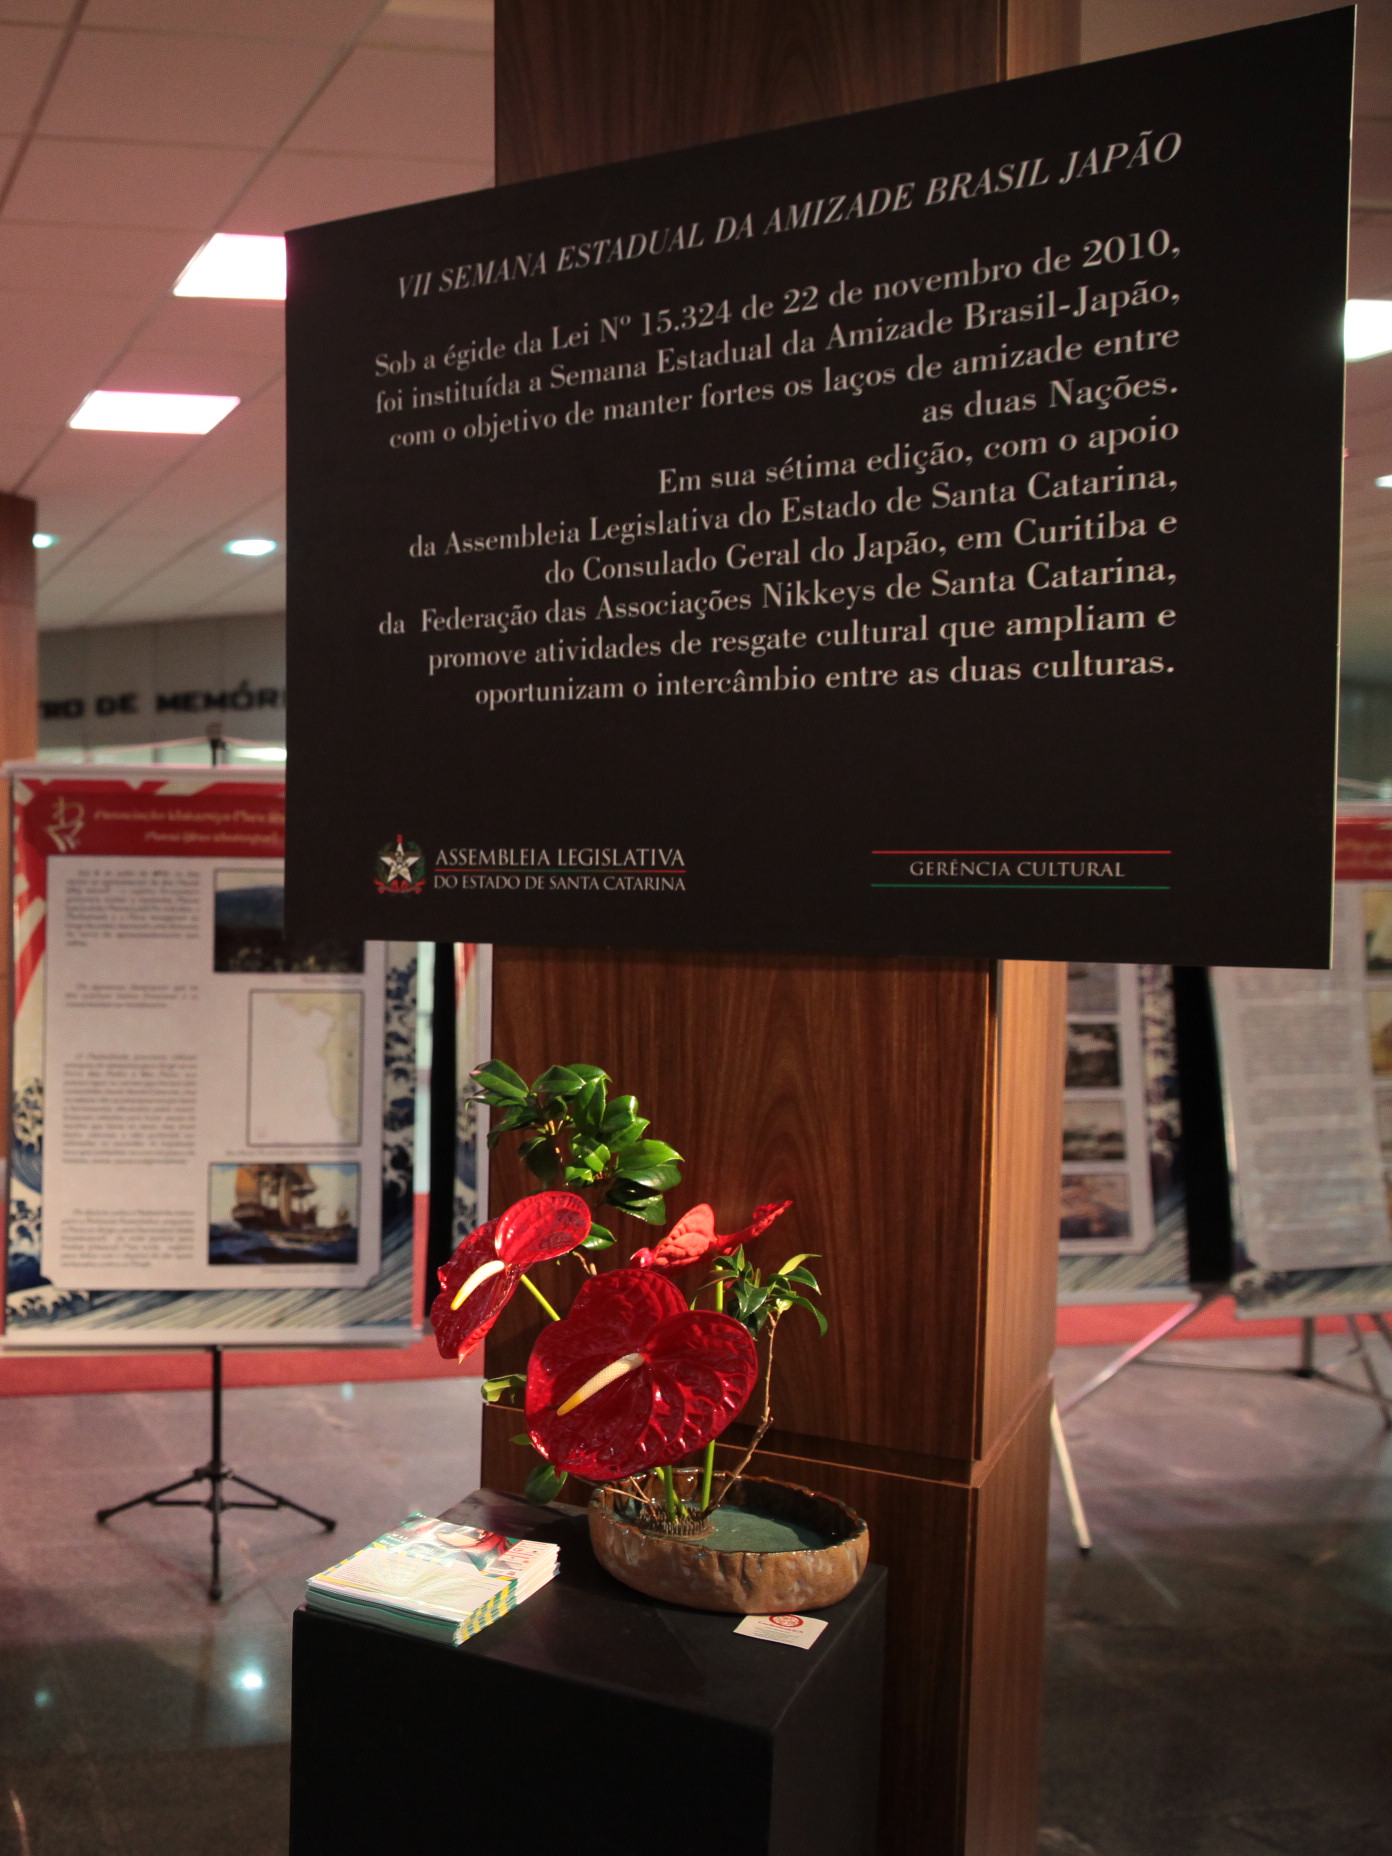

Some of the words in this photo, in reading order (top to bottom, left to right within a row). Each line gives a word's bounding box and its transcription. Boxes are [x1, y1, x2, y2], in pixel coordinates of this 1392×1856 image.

[398, 272, 433, 300] VII
[439, 250, 548, 293] SEMANA
[556, 221, 706, 274] ESTADUAL
[714, 213, 754, 245] DA
[763, 181, 916, 234] AMIZADE
[924, 157, 1049, 206] BRASIL
[1058, 130, 1182, 185] JAPÃO
[375, 350, 417, 377] Sob
[423, 354, 436, 370] a
[443, 336, 506, 371] égide
[513, 330, 543, 355] da
[552, 322, 589, 350] Lei
[643, 299, 732, 336] 15.324
[741, 293, 774, 320] de
[783, 285, 819, 315] 22
[828, 279, 863, 307] de
[874, 257, 1023, 301] novembro
[1032, 245, 1072, 275] de
[1082, 229, 1181, 268] 2010,
[376, 388, 403, 414] foi
[412, 372, 521, 409] instituída
[528, 376, 542, 393] a
[550, 361, 647, 389] Semana
[657, 332, 772, 374] Estadual
[781, 328, 816, 356] da
[826, 308, 953, 350] Amizade
[965, 279, 1180, 330] Brasil-Japão,
[389, 429, 435, 448] com
[442, 427, 457, 441] o
[462, 408, 558, 443] objetivo
[564, 400, 595, 426] de
[603, 394, 693, 421] manter
[701, 382, 775, 409] fortes
[783, 379, 814, 397] os
[824, 366, 897, 397] laços
[906, 353, 943, 381] de
[952, 334, 1083, 376] amizade
[1093, 329, 1180, 357] entre
[921, 404, 954, 424] as
[963, 389, 1037, 418] duas
[1049, 374, 1178, 411] Nações.
[659, 467, 702, 495] Em
[710, 468, 756, 488] sua
[765, 453, 857, 483] sétima
[866, 441, 973, 475] edição,
[983, 436, 1048, 460] com
[1058, 434, 1078, 451] o
[1087, 414, 1180, 456] apoio
[408, 533, 436, 558] da
[445, 520, 581, 555] Assembleia
[590, 507, 729, 545] Legislativa
[737, 500, 772, 527] do
[781, 490, 877, 524] Estado
[885, 485, 922, 514] de
[931, 481, 1017, 509] Santa
[1027, 464, 1178, 500] Catarina,
[544, 559, 575, 584] do
[582, 546, 718, 581] Consulado
[725, 538, 800, 570] Geral
[810, 535, 845, 563] do
[852, 531, 947, 565] Japão,
[956, 530, 1002, 551] em
[1013, 509, 1148, 546] Curitiba
[1158, 515, 1178, 535] e
[378, 611, 406, 635] da
[421, 604, 538, 634] Federação
[544, 598, 587, 624] das
[595, 589, 752, 621] Associações
[762, 578, 876, 611] Nikkeys
[885, 572, 922, 600] de
[931, 569, 1016, 597] Santa
[1026, 556, 1177, 590] Catarina,
[428, 649, 527, 677] promove
[534, 632, 662, 664] atividades
[670, 629, 702, 655] de
[711, 628, 807, 658] resgate
[816, 613, 929, 647] cultural
[938, 620, 996, 648] que
[1005, 603, 1146, 642] ampliam
[1156, 609, 1177, 628] e
[95, 692, 139, 718] DE
[156, 678, 288, 713] MEMÓR
[474, 676, 624, 711] oportunizam
[632, 681, 648, 697] o
[657, 664, 817, 697] intercâmbio
[824, 666, 899, 689] entre
[907, 667, 940, 686] as
[949, 655, 1022, 683] duas
[1031, 649, 1175, 680] culturas.
[433, 875, 459, 889] DO
[462, 875, 521, 889] ESTADO
[524, 875, 543, 890] DE
[549, 876, 600, 890] SANTA
[602, 876, 686, 891] CATARINA
[435, 848, 551, 866] ASSEMBLEIA
[557, 848, 685, 867] LEGISLATIVA
[909, 857, 1011, 877] GERÊNCIA
[1016, 861, 1124, 877] CULTURAL
